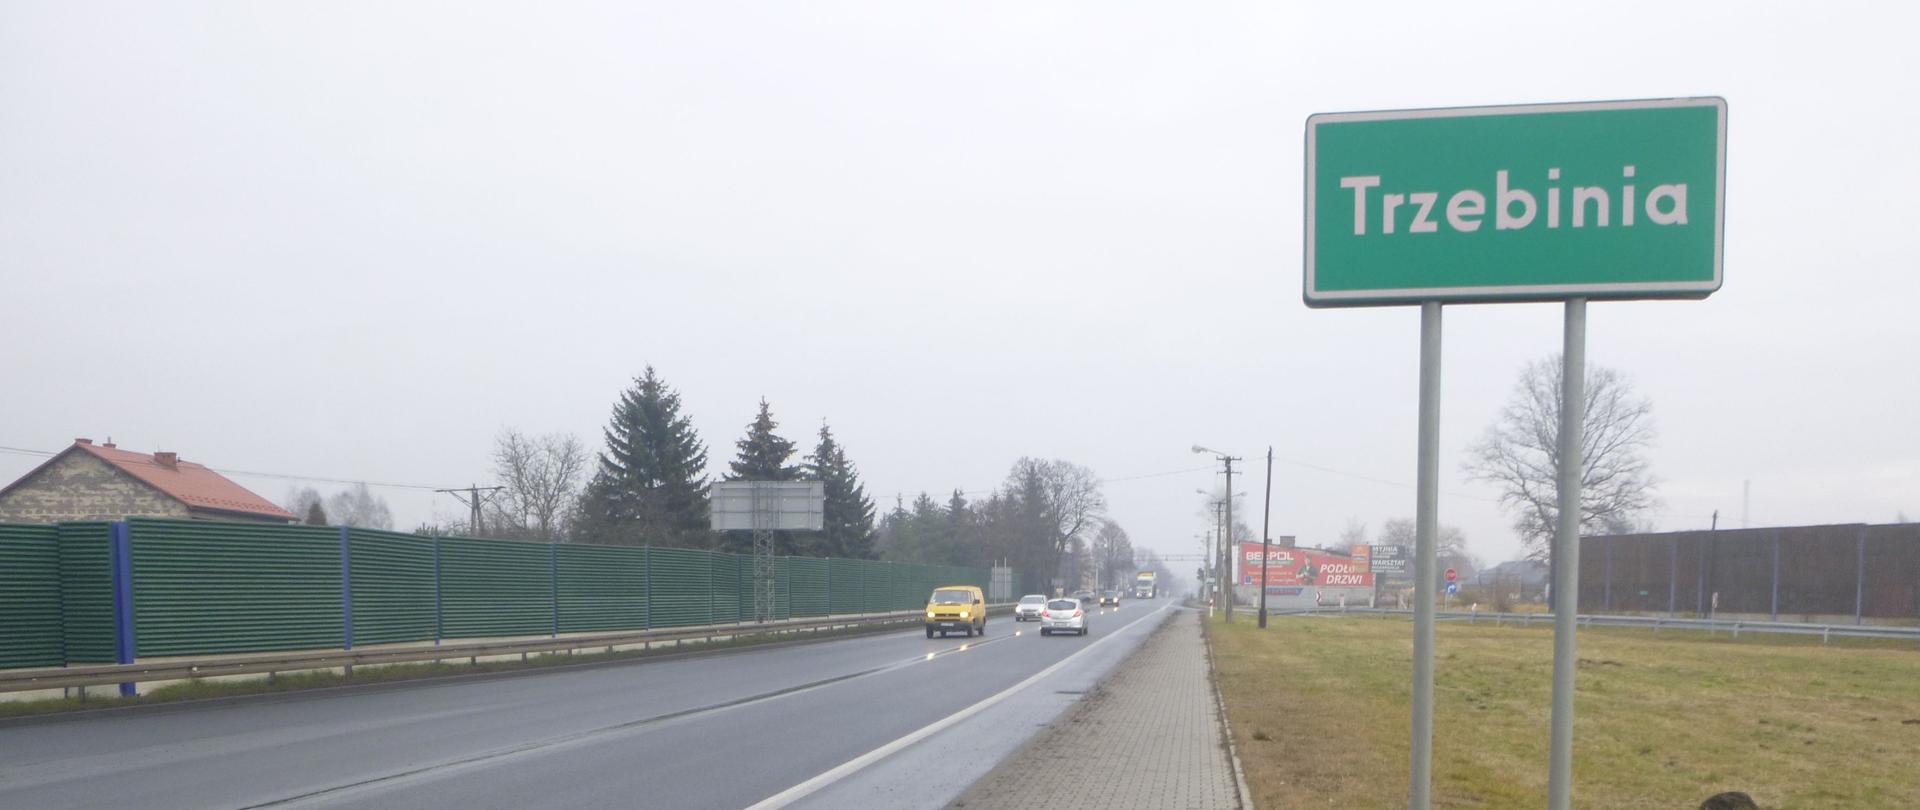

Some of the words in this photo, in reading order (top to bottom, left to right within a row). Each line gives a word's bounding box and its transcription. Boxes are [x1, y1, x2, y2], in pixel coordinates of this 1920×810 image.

[1340, 165, 1689, 236] Trzebinia
[1372, 559, 1405, 567] WARSZTAT
[1326, 574, 1363, 585] DRZWI
